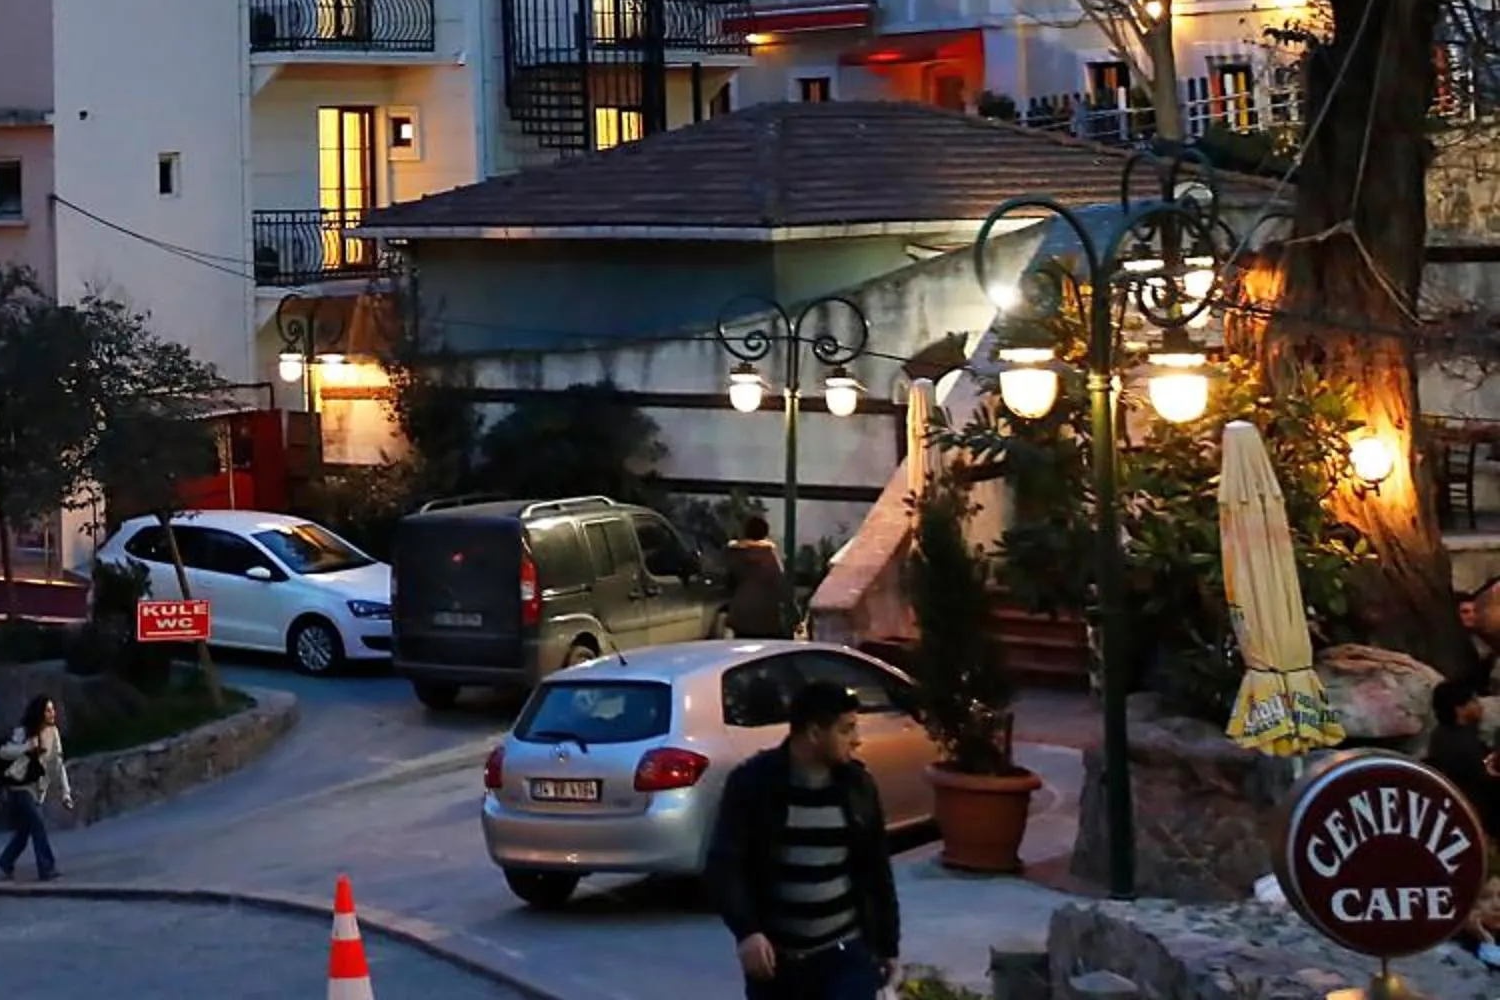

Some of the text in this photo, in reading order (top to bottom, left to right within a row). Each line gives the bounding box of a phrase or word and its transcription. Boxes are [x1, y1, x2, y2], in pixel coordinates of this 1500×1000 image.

[142, 603, 207, 617] KULE
[155, 617, 194, 629] WC
[1306, 786, 1471, 878] CENEVİZ
[1331, 887, 1456, 922] CAFE
